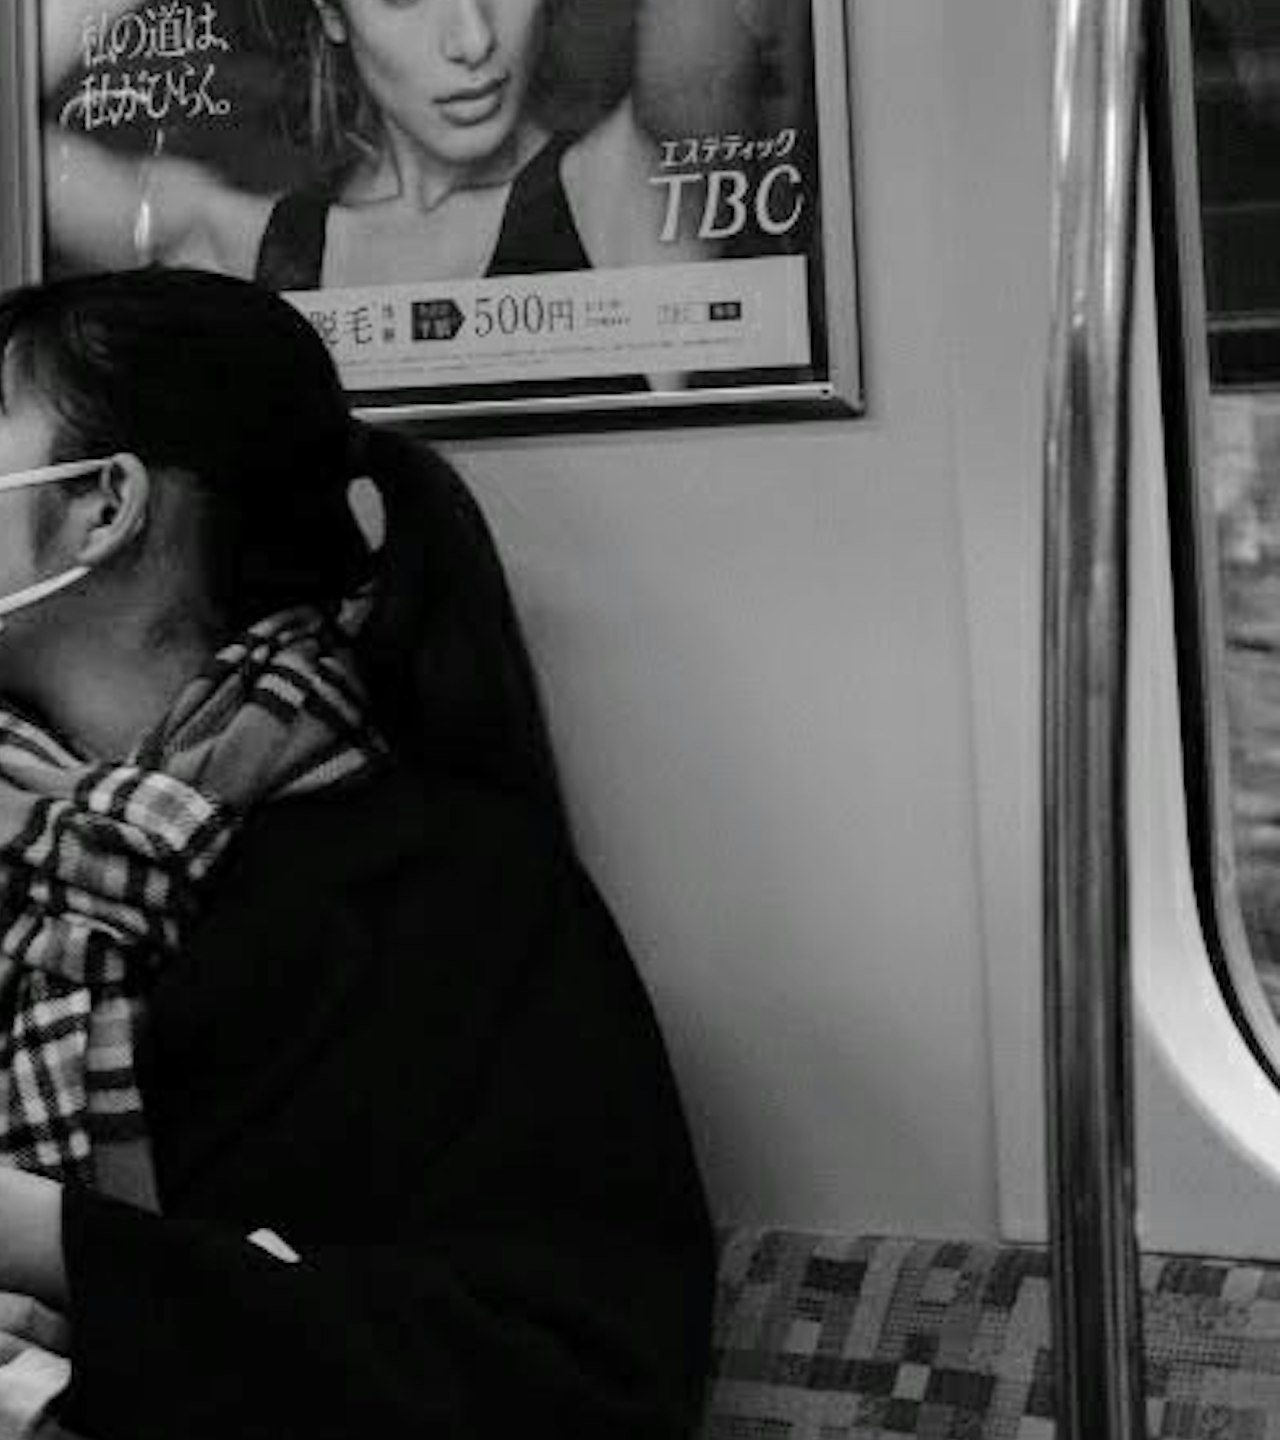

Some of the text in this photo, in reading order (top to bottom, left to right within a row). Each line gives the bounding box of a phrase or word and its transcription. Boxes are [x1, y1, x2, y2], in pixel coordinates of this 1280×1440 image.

[60, 63, 231, 133] 私がひらく。
[660, 128, 798, 169] エステティック
[649, 163, 804, 242] TBC
[473, 293, 575, 337] 500円
